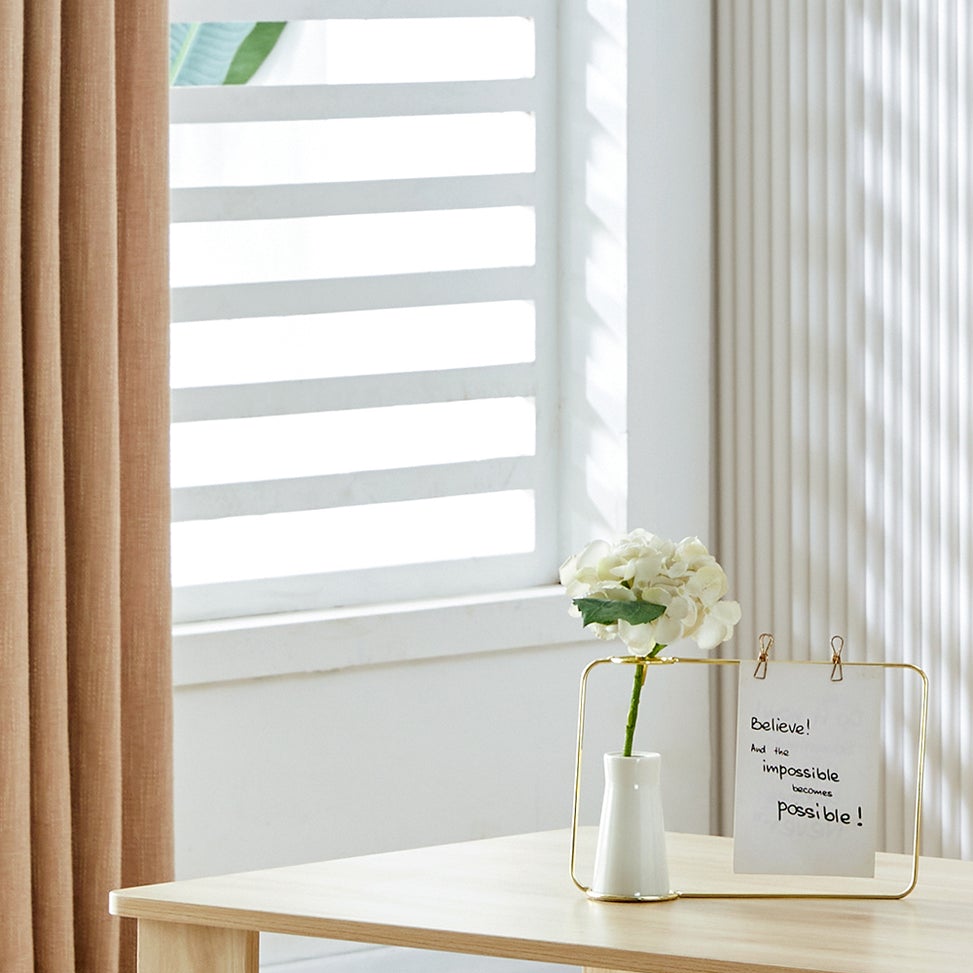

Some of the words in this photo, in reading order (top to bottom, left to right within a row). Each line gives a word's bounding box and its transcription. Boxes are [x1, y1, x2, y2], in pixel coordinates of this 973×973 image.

[750, 716, 811, 736] Believe!
[750, 744, 766, 754] And
[774, 747, 790, 757] the
[762, 759, 840, 783] impossible
[792, 784, 833, 798] becomes
